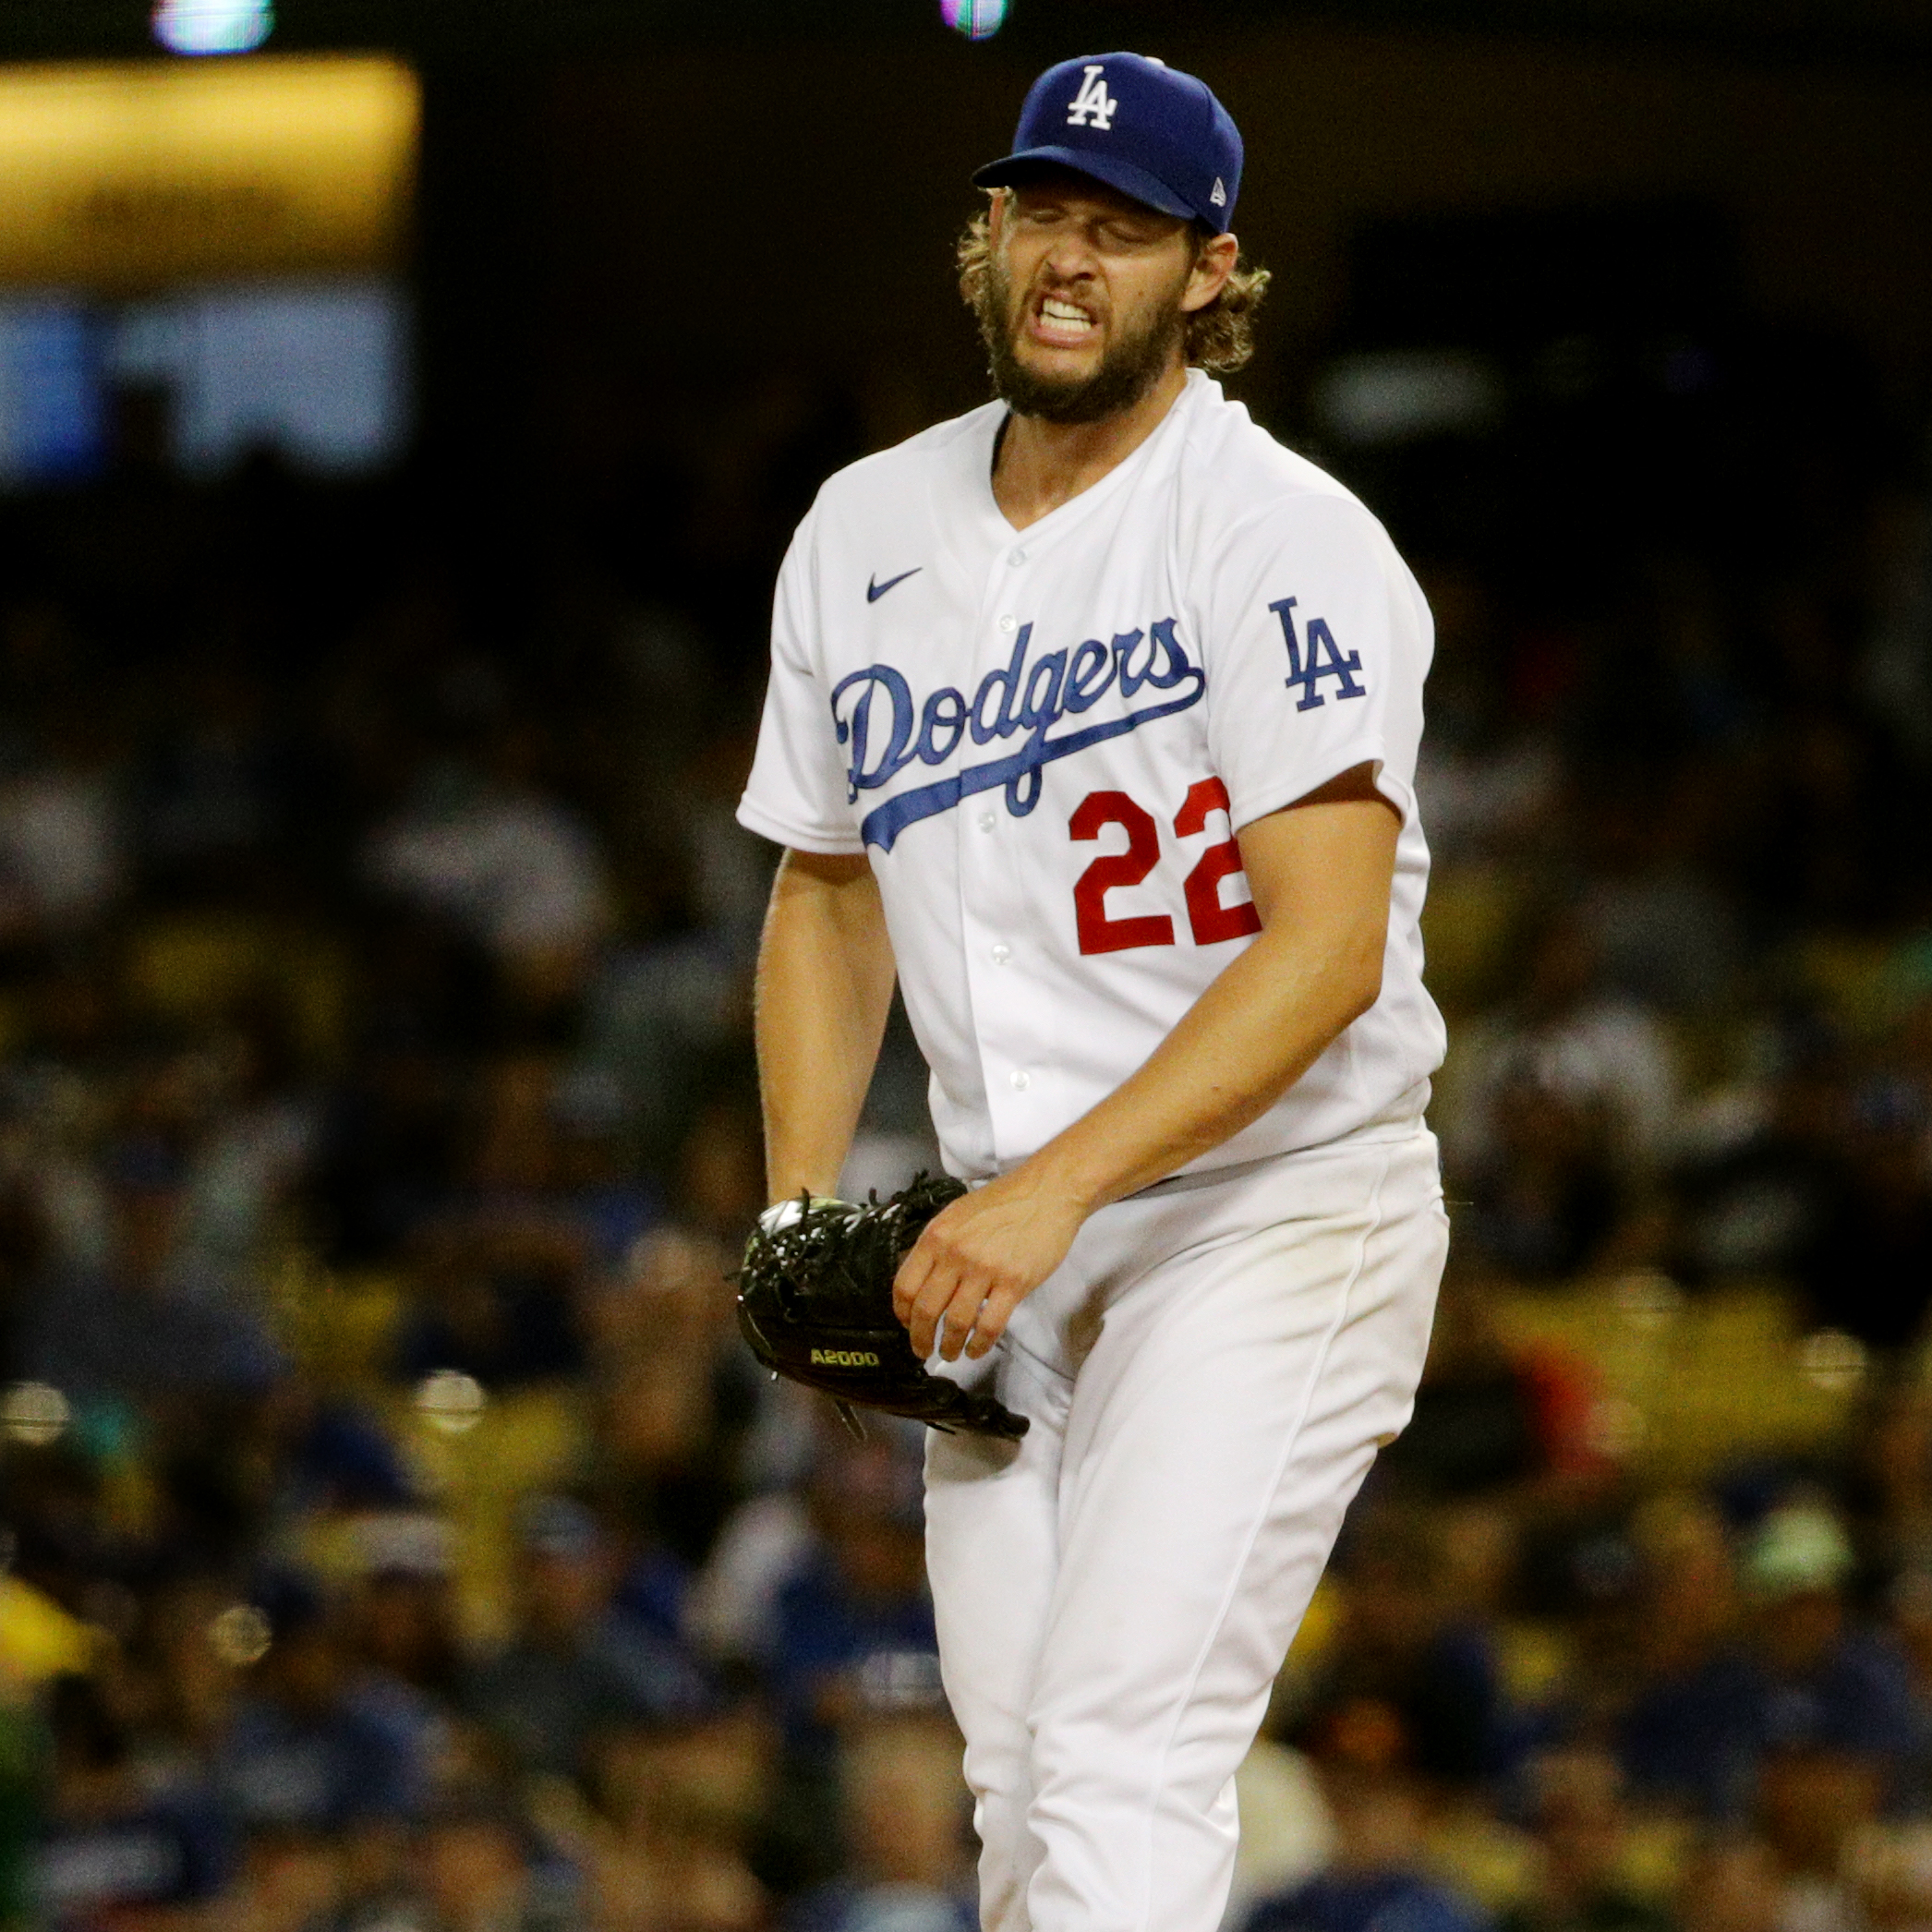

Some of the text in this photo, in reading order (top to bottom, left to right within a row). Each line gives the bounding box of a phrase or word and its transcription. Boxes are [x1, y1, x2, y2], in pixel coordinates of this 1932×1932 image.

[1067, 65, 1118, 130] LA
[1268, 596, 1367, 711] LA
[830, 616, 1205, 818] Dodgers
[1069, 775, 1262, 955] 22
[810, 1348, 879, 1367] A2000
